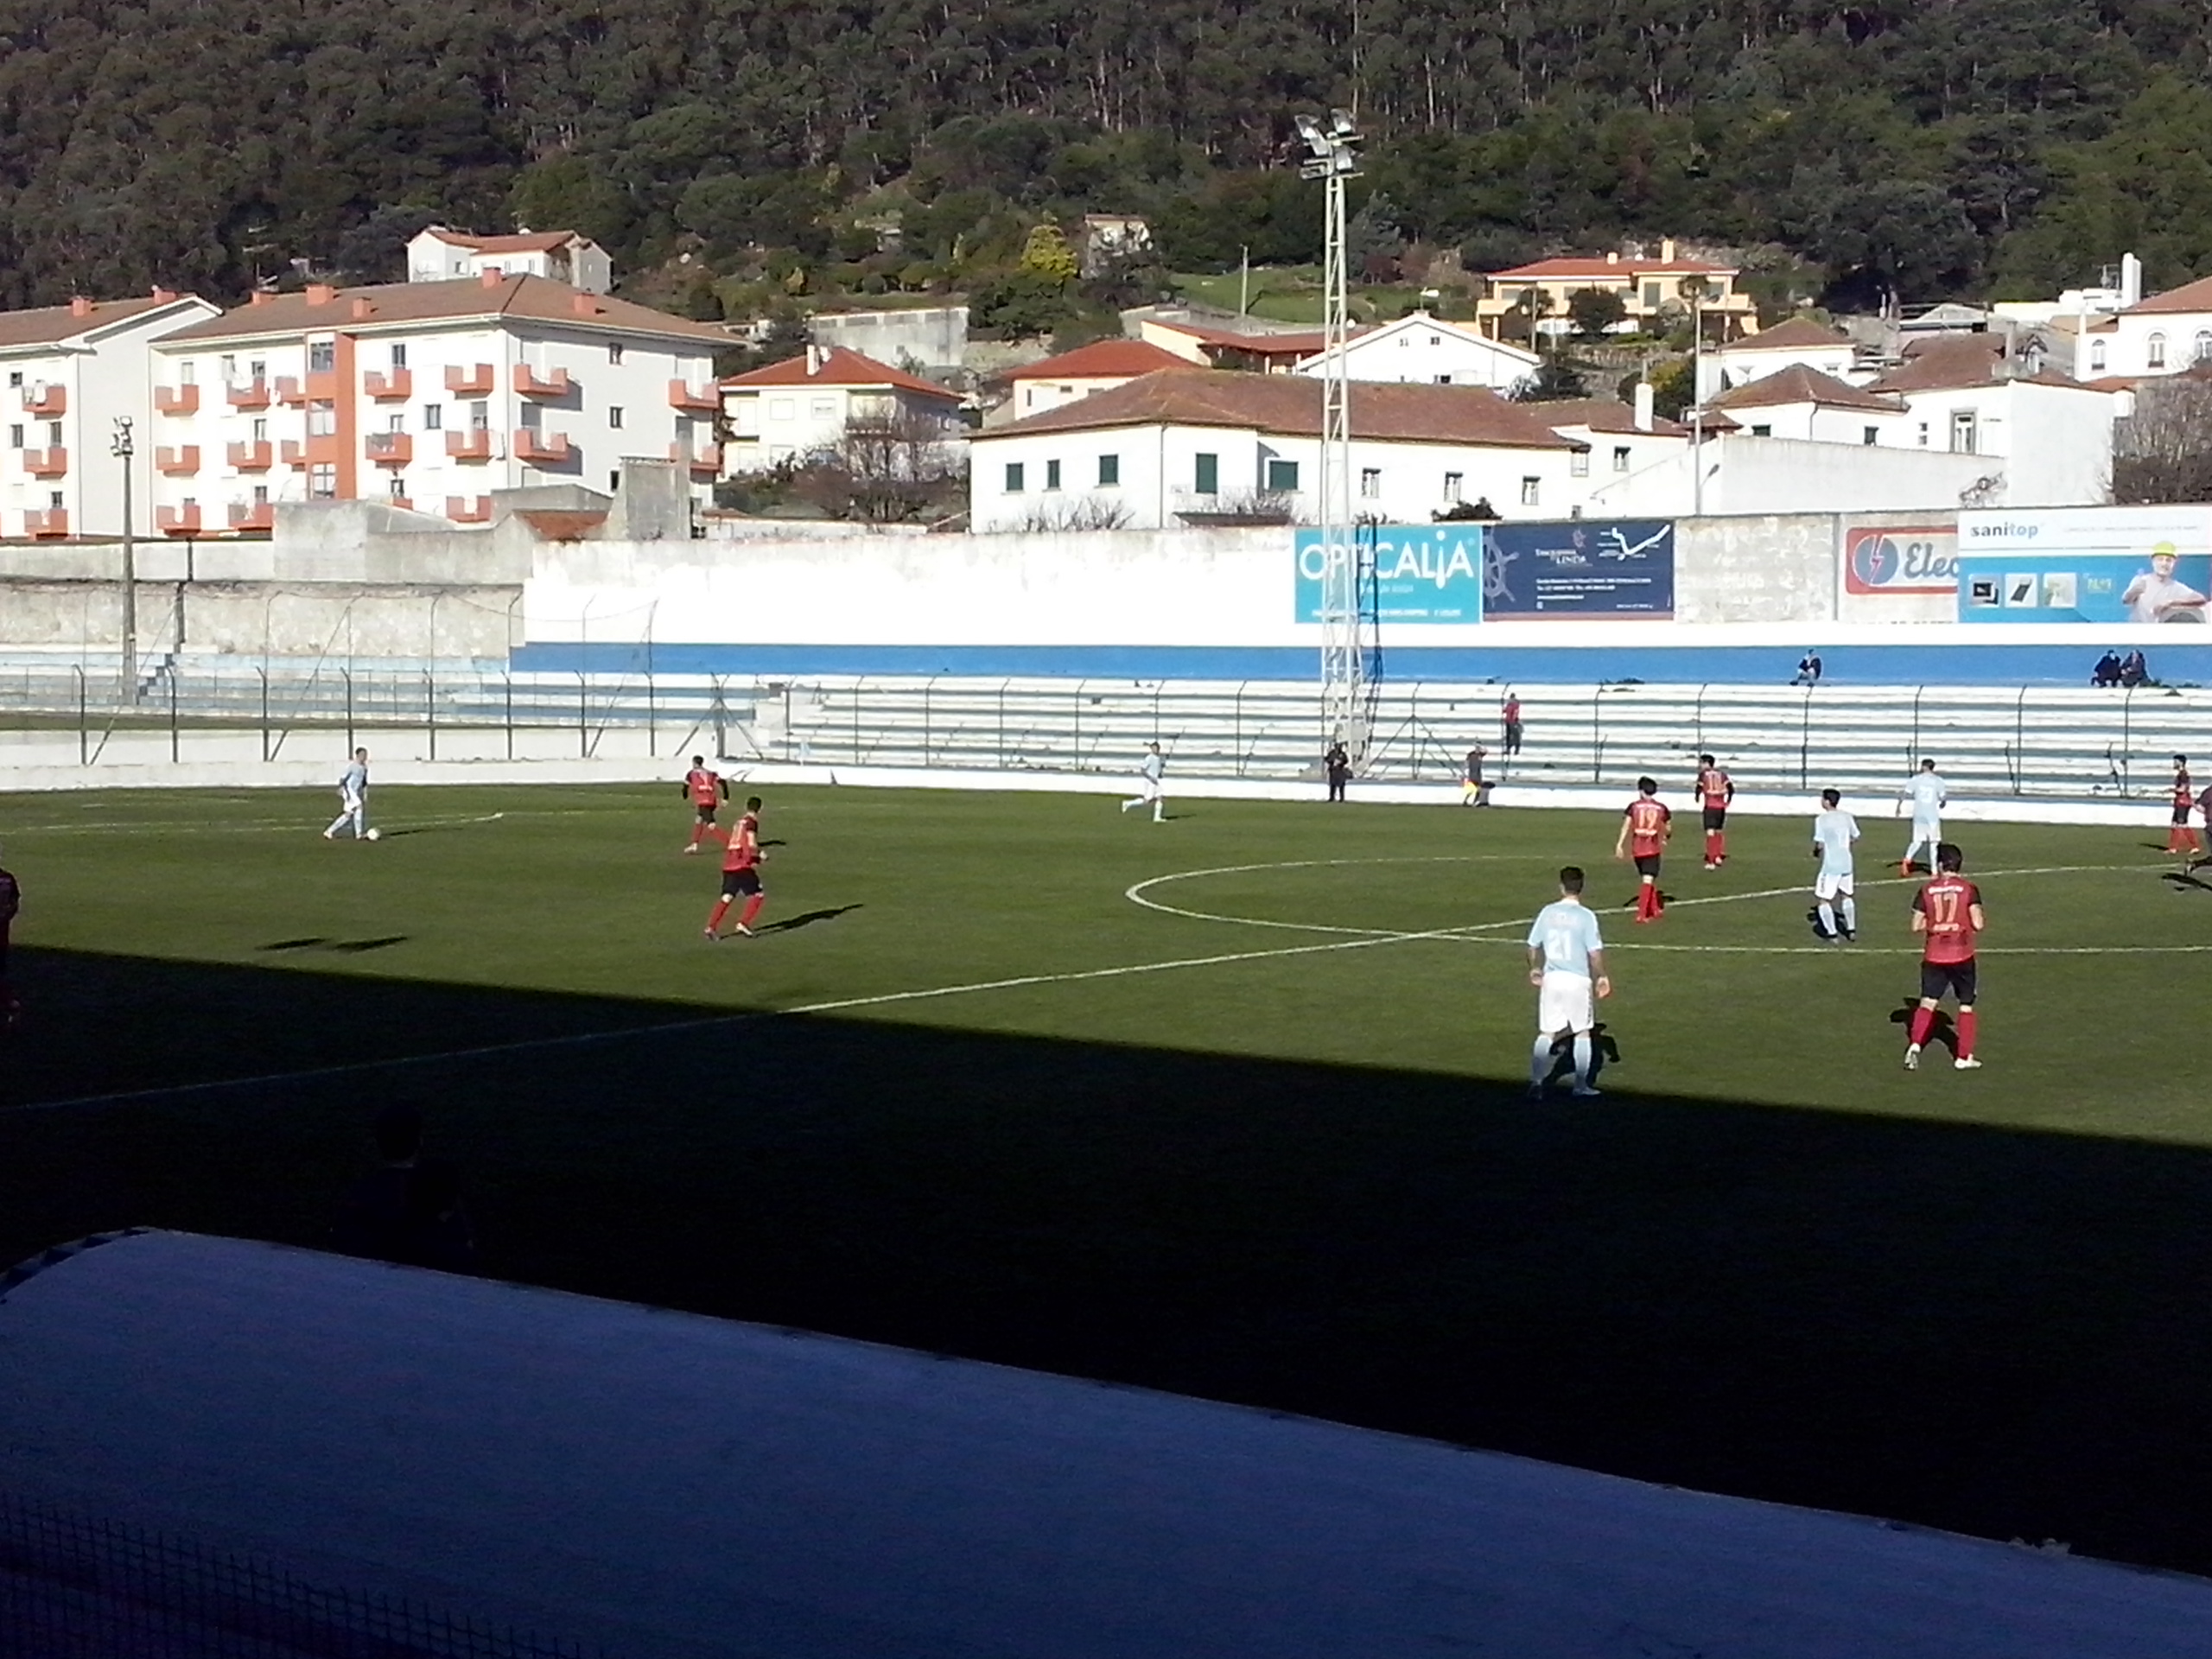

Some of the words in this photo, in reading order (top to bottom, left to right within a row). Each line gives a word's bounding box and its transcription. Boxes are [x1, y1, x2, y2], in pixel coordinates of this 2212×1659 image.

[1970, 522, 2038, 538] sanitop
[1639, 809, 1657, 829] 19
[1933, 893, 1958, 923] 17
[1547, 929, 1571, 960] 21
